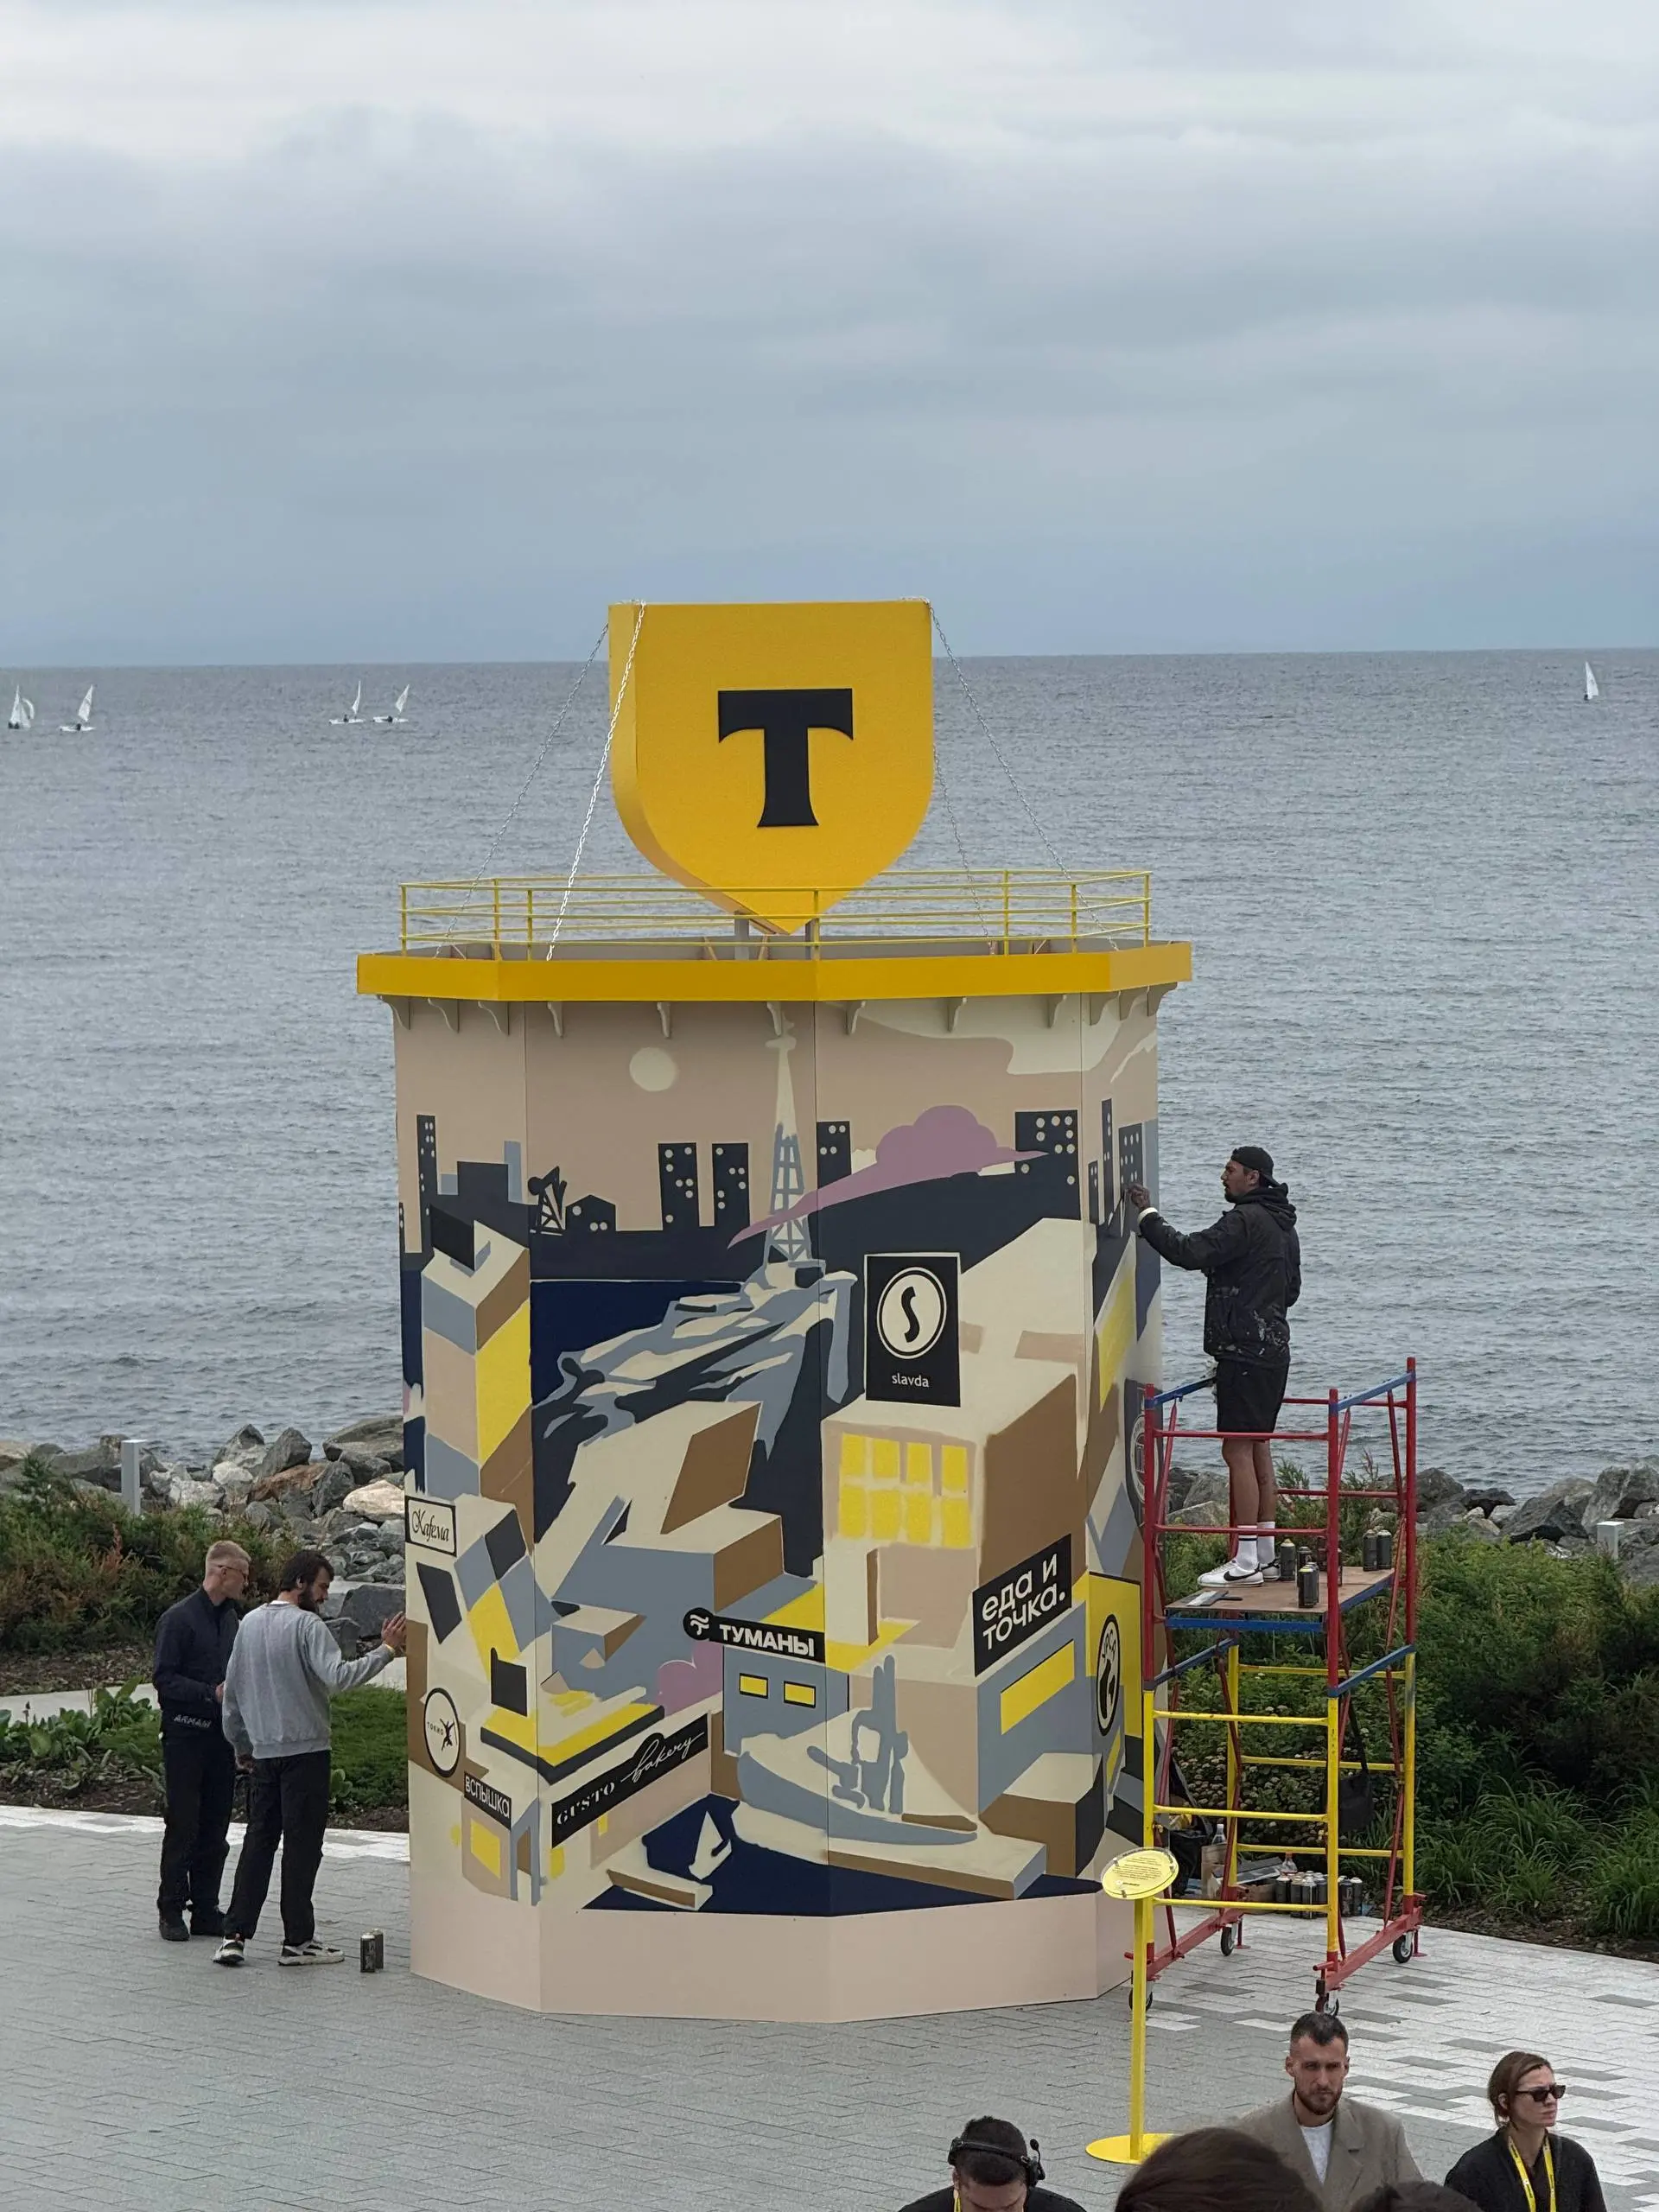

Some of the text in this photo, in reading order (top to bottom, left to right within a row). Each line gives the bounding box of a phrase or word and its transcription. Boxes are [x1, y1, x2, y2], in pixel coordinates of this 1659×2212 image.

[892, 1373, 929, 1388] slavda
[982, 1554, 1058, 1622] еда и
[982, 1583, 1065, 1650] точка.
[719, 1624, 815, 1657] ТУМАНЫ
[556, 1732, 705, 1825] GUSTO bakery
